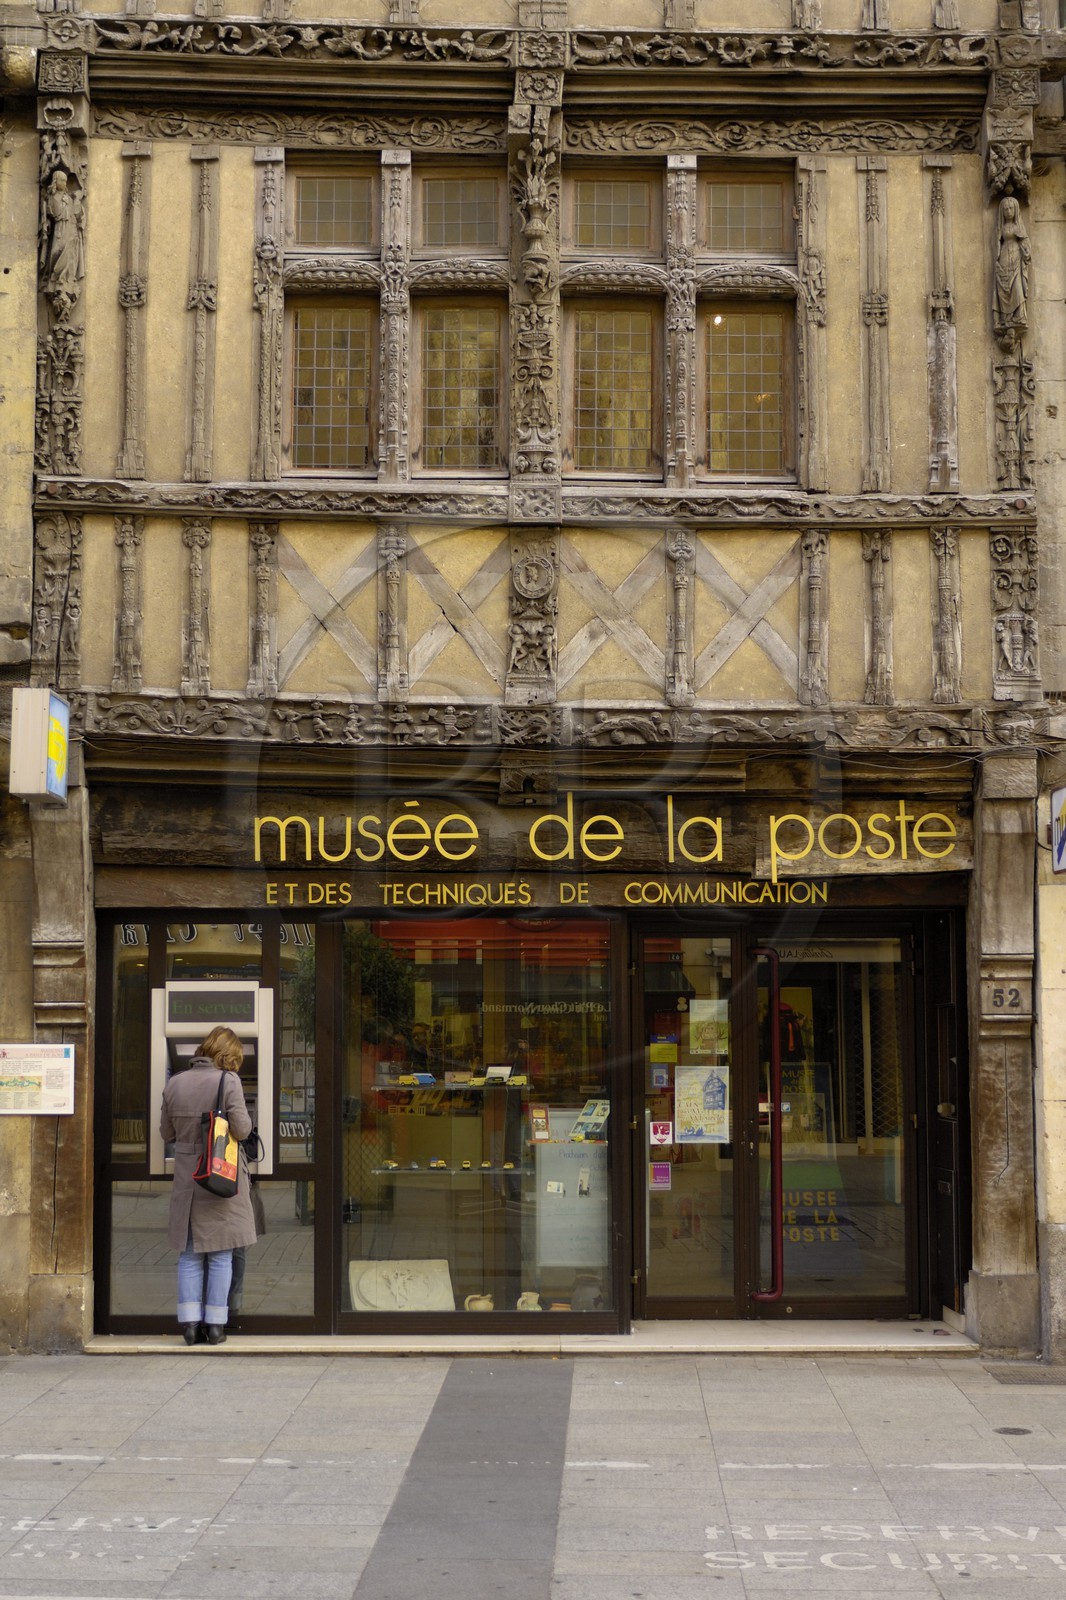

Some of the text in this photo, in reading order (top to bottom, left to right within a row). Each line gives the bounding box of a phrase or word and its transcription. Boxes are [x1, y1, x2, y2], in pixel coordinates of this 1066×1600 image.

[254, 791, 957, 884] musée de la poste
[266, 881, 828, 905] ET DES TECHNIQUES DE COMMUNICATION
[171, 999, 252, 1015] En service
[992, 988, 1020, 1008] 52
[814, 1209, 838, 1224] LA
[702, 1523, 1066, 1542] RESERV
